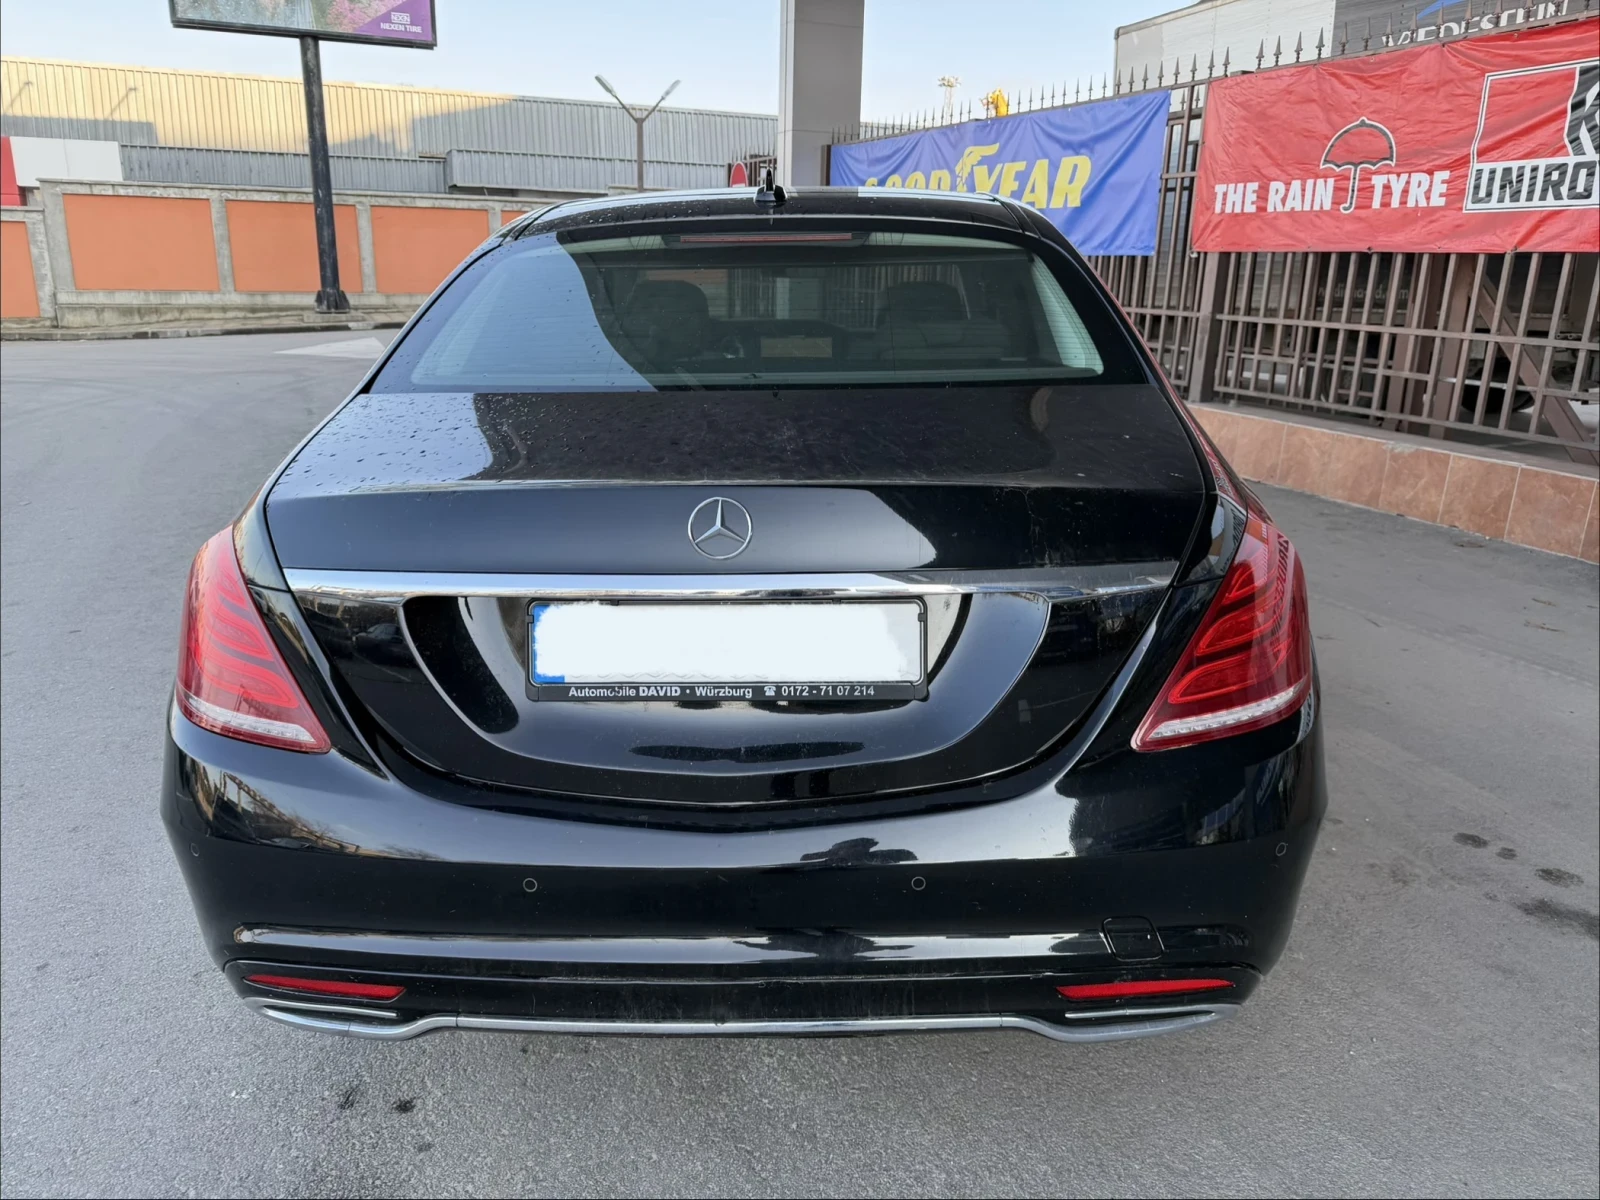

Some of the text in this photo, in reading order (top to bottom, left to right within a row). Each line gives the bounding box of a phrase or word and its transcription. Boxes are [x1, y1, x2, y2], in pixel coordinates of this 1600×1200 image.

[380, 22, 422, 33] NEXEN TIRE
[1214, 170, 1451, 214] THE RAIN TYRE
[568, 686, 636, 697] Automobile
[639, 686, 681, 697] DAVID
[695, 686, 753, 699] Würzburg
[781, 685, 809, 697] 0172
[820, 685, 834, 697] 71
[836, 685, 850, 697] 07
[853, 685, 875, 697] 214
